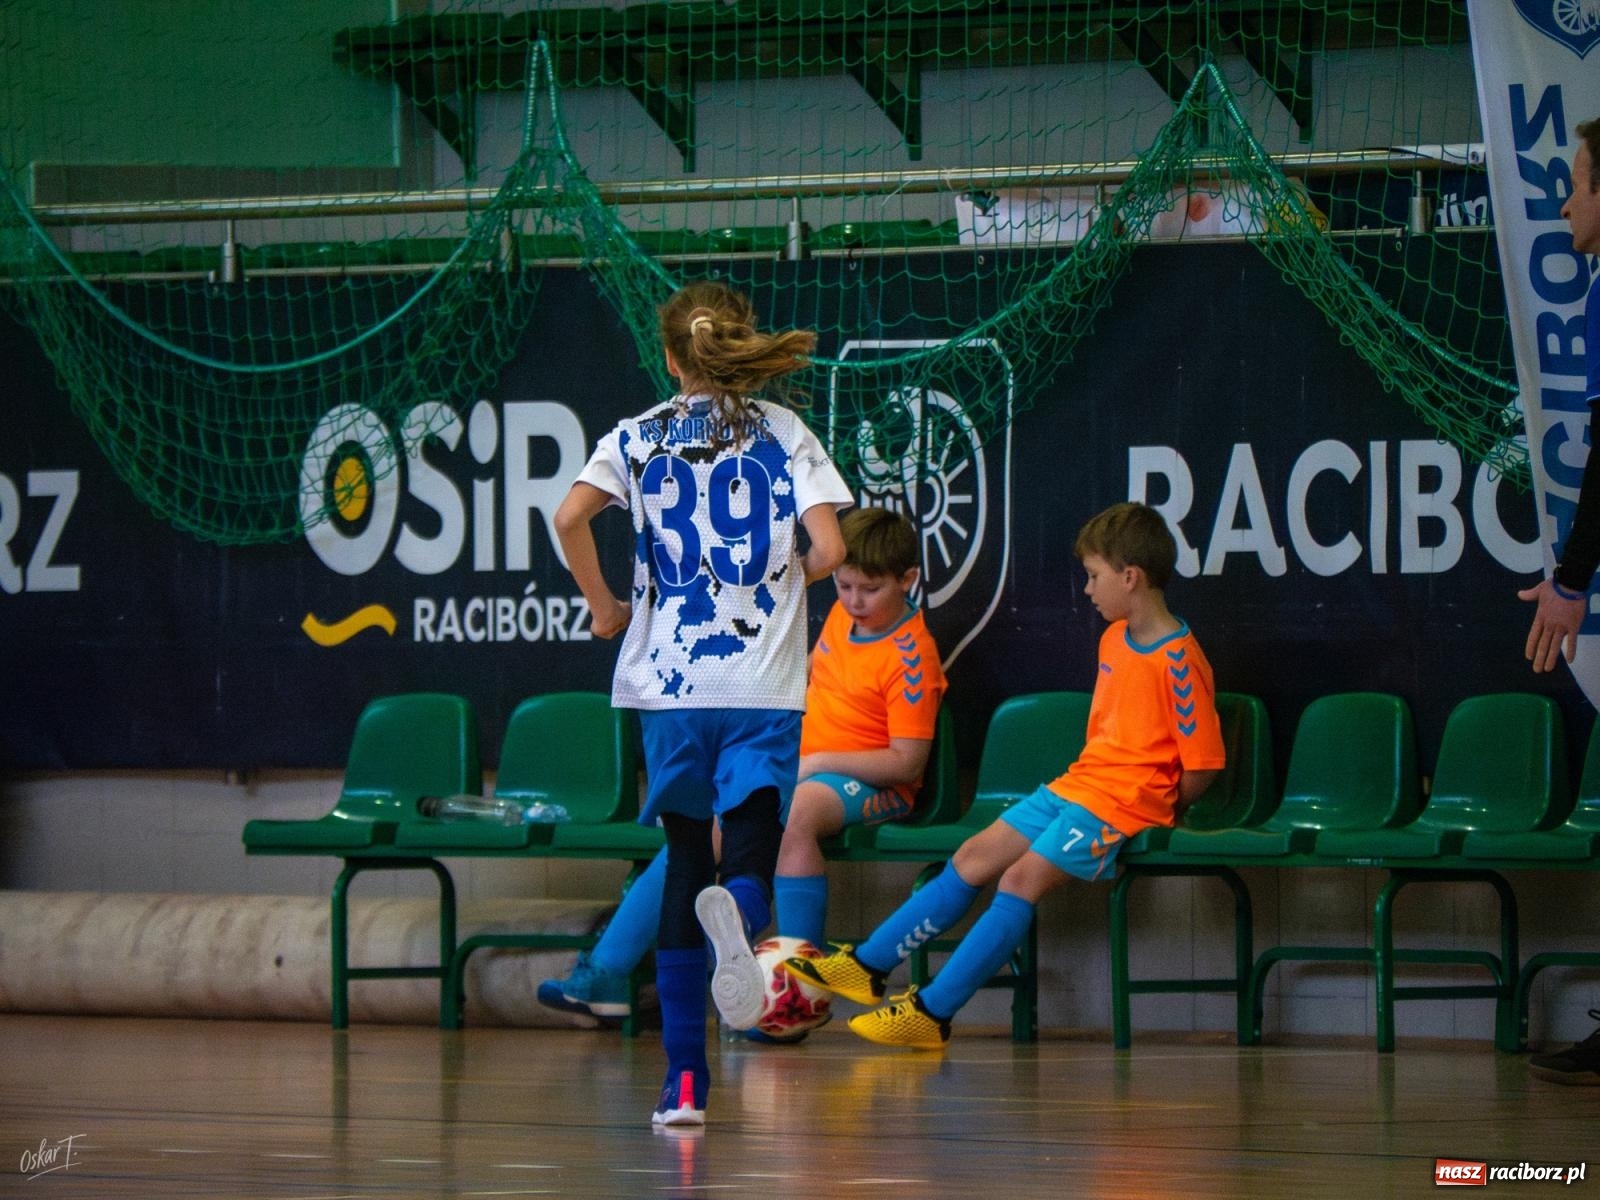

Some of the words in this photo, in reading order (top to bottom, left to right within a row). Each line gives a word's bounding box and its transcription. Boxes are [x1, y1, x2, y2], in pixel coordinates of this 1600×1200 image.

[640, 419, 663, 443] KS
[299, 400, 588, 576] OSiR
[640, 453, 772, 588] 39
[413, 581, 593, 642] RACIBÓRZ
[843, 780, 862, 797] 8
[1062, 827, 1085, 853] 7
